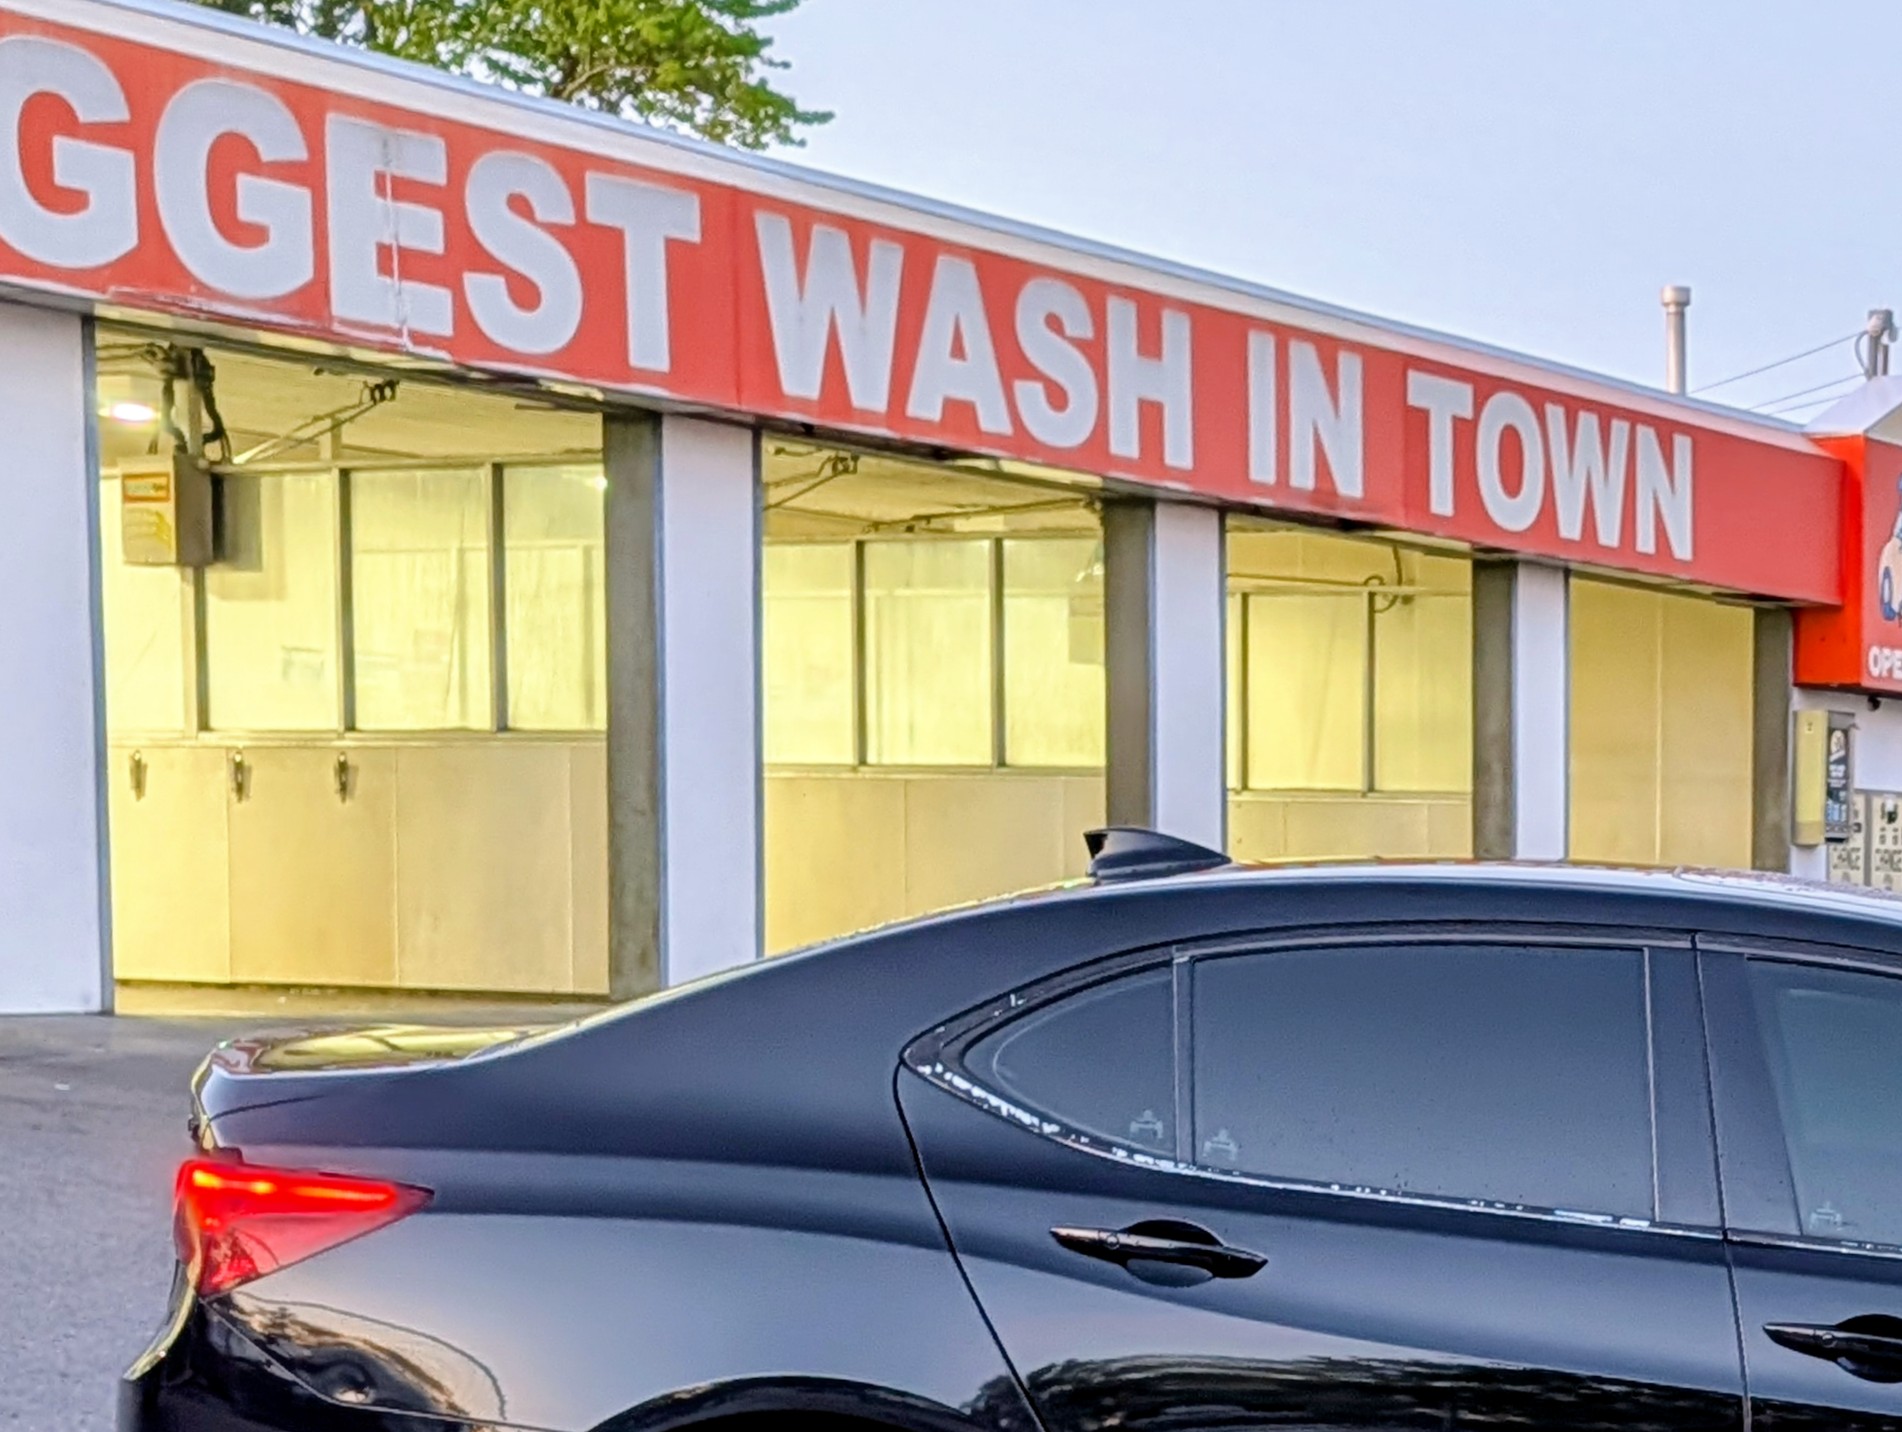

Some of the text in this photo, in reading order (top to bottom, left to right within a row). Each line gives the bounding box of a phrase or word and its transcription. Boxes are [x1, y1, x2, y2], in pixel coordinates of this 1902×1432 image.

[0, 35, 1694, 561] GGEST WASH IN TOWN
